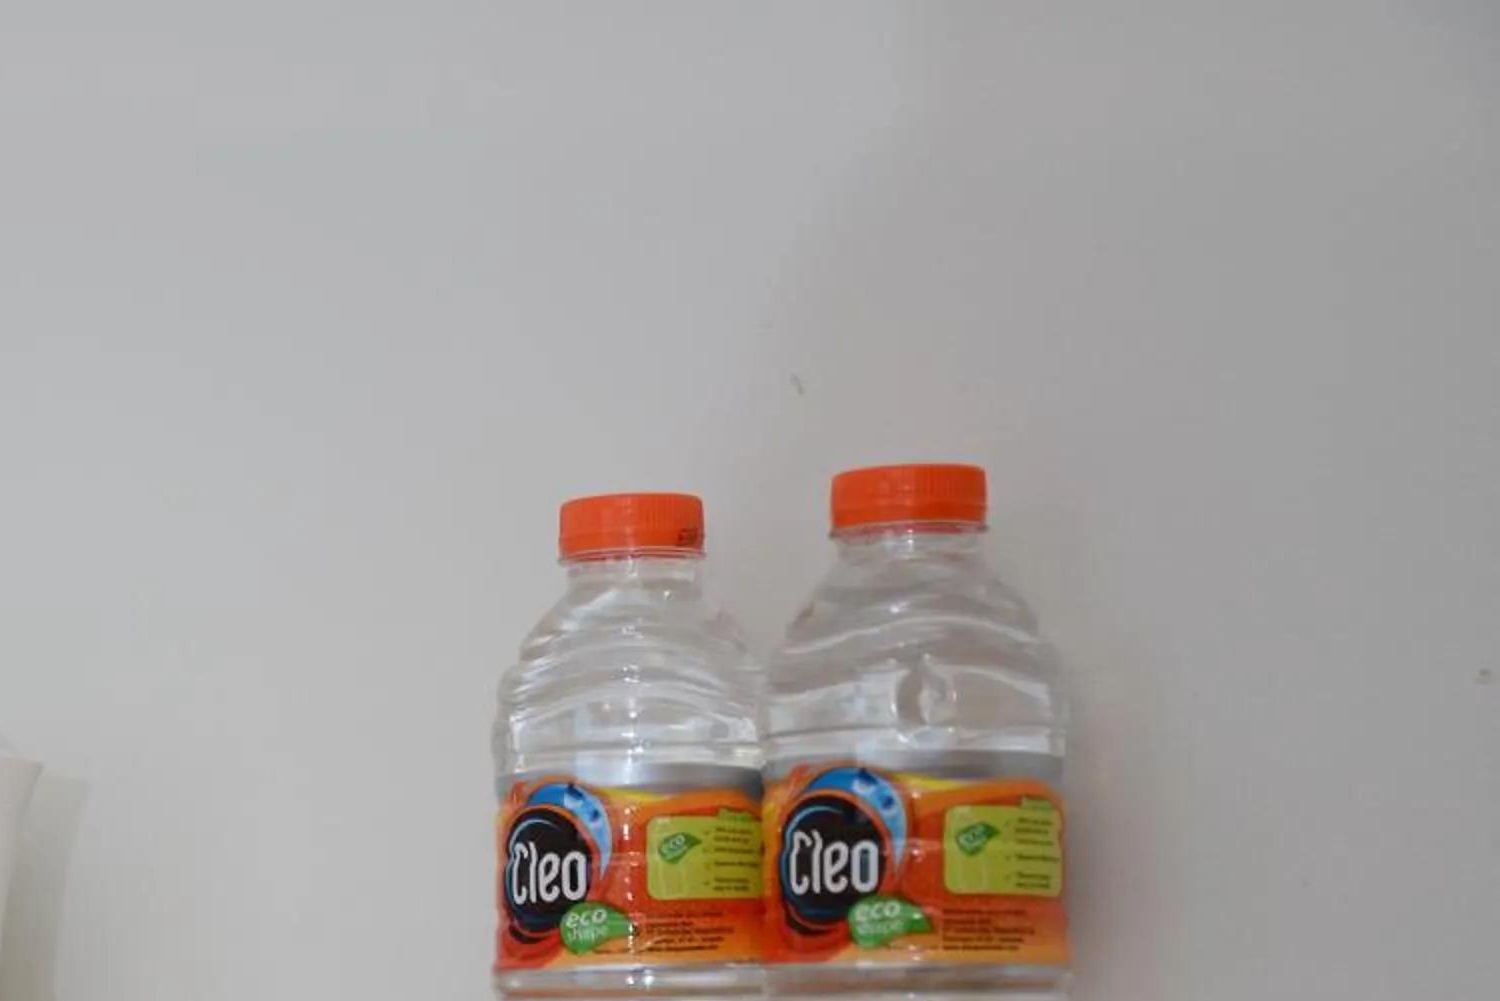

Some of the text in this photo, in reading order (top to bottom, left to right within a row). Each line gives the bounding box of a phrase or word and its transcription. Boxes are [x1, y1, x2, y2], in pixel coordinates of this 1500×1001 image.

[512, 841, 587, 905] Cleo
[790, 829, 879, 895] Cleo
[565, 908, 608, 928] eco
[854, 902, 901, 922] eco
